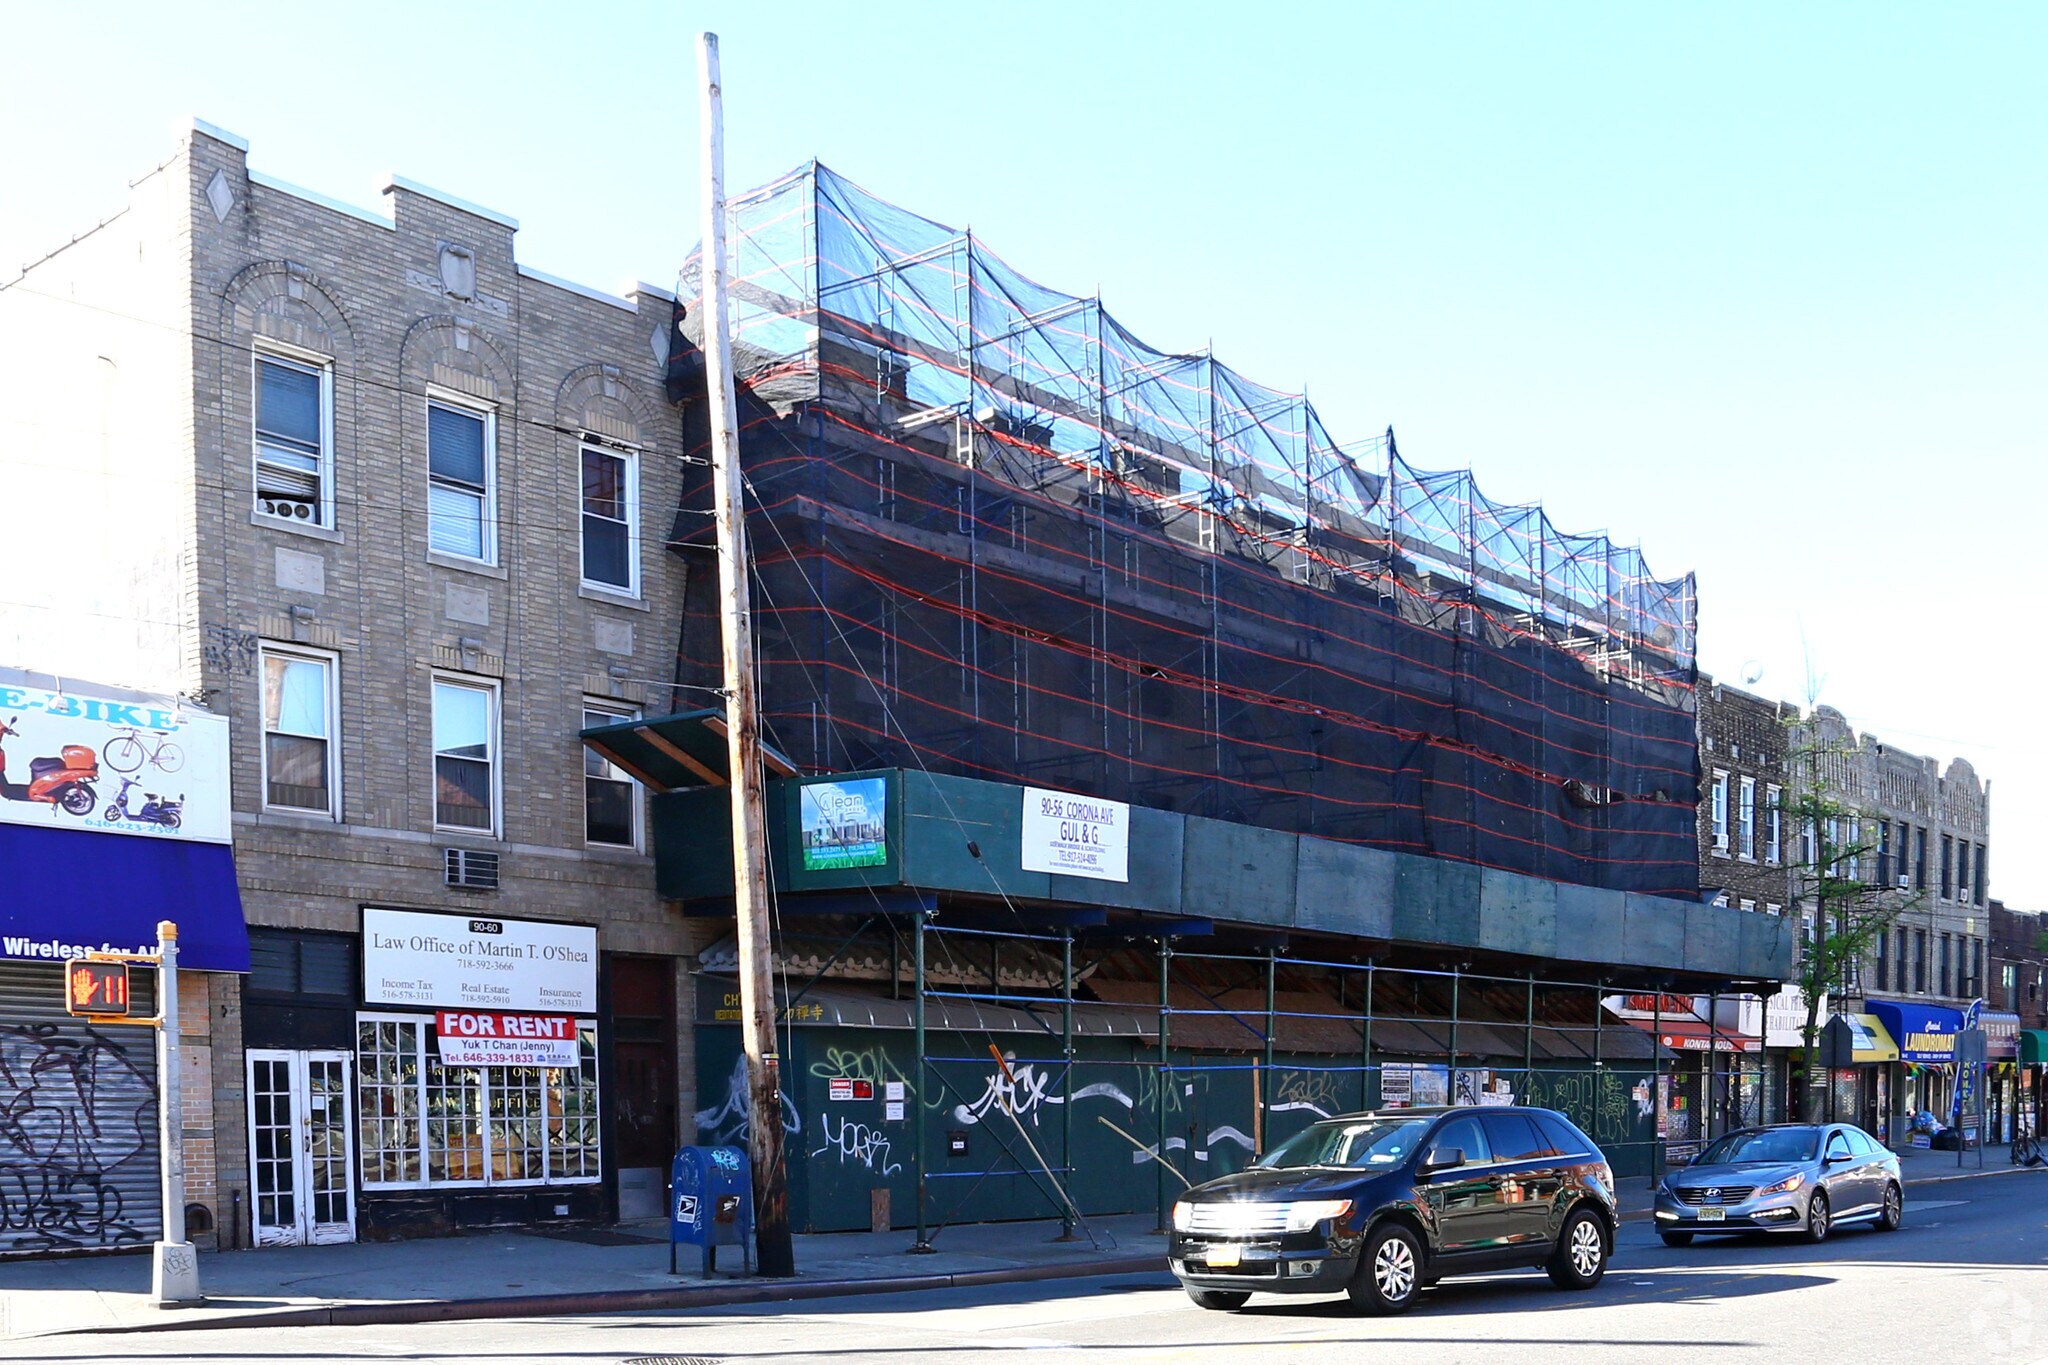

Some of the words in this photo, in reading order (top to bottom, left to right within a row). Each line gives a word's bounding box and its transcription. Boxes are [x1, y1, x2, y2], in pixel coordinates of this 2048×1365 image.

[1041, 797, 1063, 816] 90-56
[1066, 801, 1099, 822] CORONA
[1101, 807, 1114, 824] AVE
[1060, 821, 1080, 843] GUL
[1082, 823, 1090, 844] &
[1091, 826, 1099, 845] G
[473, 922, 498, 933] 90-60
[3, 936, 95, 959] Wireless
[373, 933, 406, 950] Law
[410, 935, 455, 954] Office
[459, 938, 474, 954] of
[478, 940, 523, 958] Martin
[526, 944, 540, 959] T.
[543, 946, 589, 963] O'Shea
[457, 958, 514, 972] 718-592-3666
[381, 978, 415, 989] Income
[417, 980, 434, 991] Tax
[461, 982, 481, 993] Real
[483, 984, 511, 995] Estate
[381, 989, 434, 1001] 516-578-3131
[539, 986, 583, 998] Insurance
[461, 994, 511, 1005] 718-592-5910
[443, 1013, 495, 1036] FOR
[502, 1014, 567, 1038] RENT
[461, 1039, 480, 1050] Yuk
[482, 1040, 489, 1050] T
[491, 1040, 517, 1051] Chan
[519, 1041, 555, 1053] (Jenny)
[1683, 1038, 1734, 1050] KONTAIOUS
[1904, 1032, 1955, 1052] LAUNDROMAT
[445, 1053, 462, 1063] Tel.
[463, 1052, 534, 1064] 646-339-1833
[427, 1097, 458, 1108] LAW
